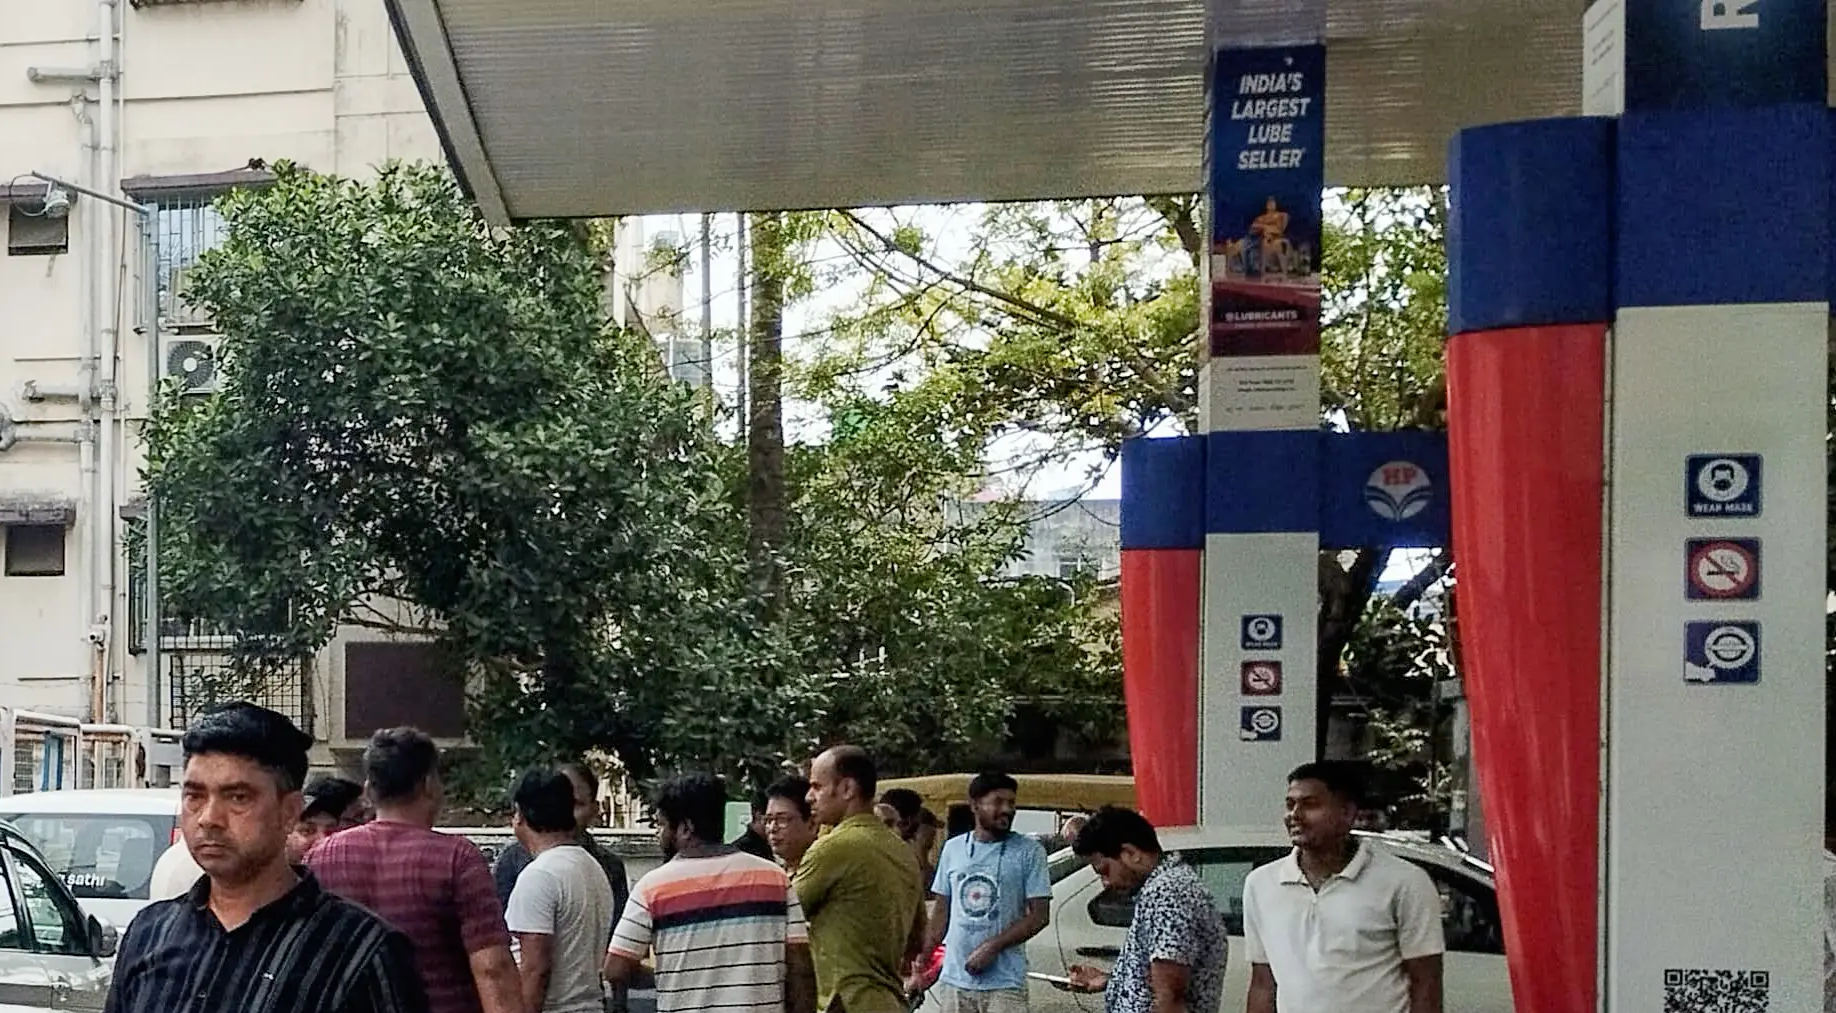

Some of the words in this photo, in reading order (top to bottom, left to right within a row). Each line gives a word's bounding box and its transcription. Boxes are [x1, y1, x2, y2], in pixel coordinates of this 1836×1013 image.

[1239, 72, 1303, 94] INDIA'S
[1231, 98, 1311, 120] LARGEST
[1248, 124, 1294, 144] LUBE
[1234, 310, 1298, 321] LUBRICANTS
[1382, 466, 1418, 486] HP
